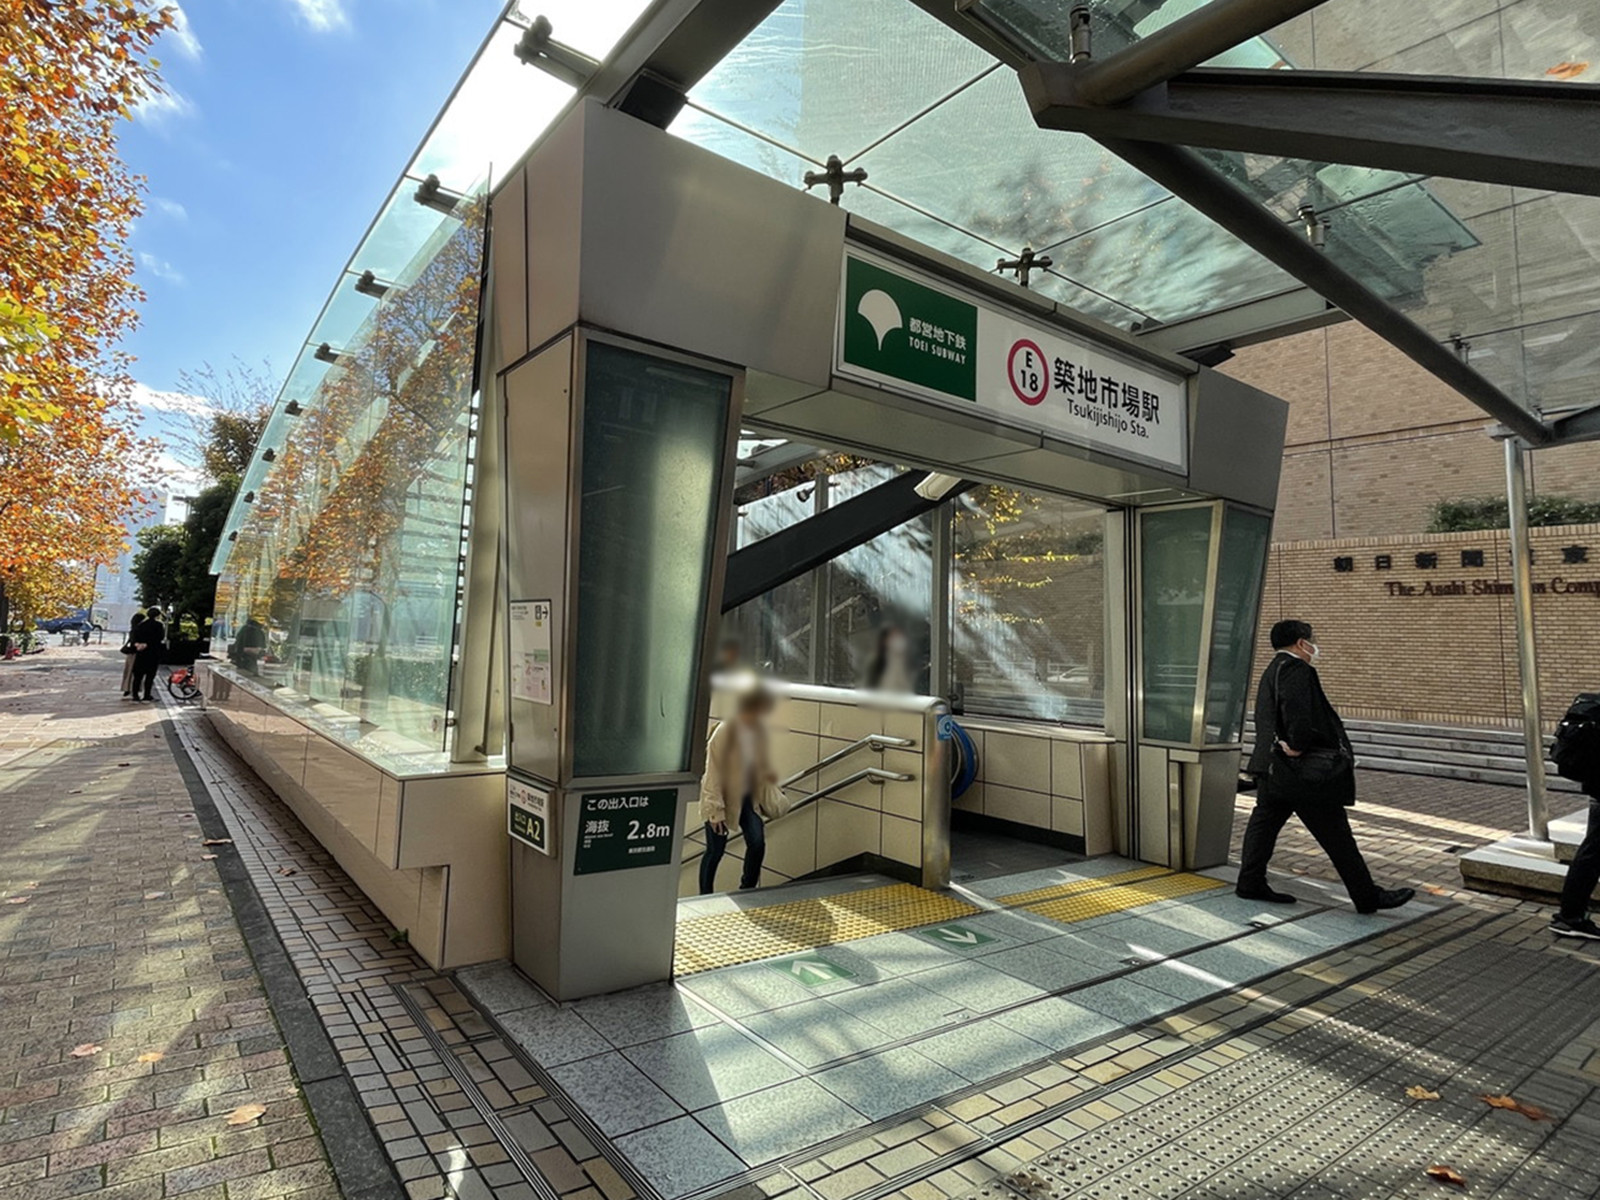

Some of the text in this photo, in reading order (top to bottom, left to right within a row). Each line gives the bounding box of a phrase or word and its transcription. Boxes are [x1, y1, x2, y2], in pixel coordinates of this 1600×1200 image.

[910, 317, 967, 350] 都営地下鉄
[909, 335, 966, 365] TOEI SUBWAY
[1025, 351, 1033, 369] E
[1021, 370, 1039, 392] 18
[1054, 357, 1160, 425] 築地市場駅
[1067, 398, 1149, 439] Tsukijishijo Sta.
[587, 796, 649, 811] この出入口は
[526, 817, 541, 841] A2
[584, 819, 610, 834] 海抜
[627, 820, 670, 840] 2.8m
